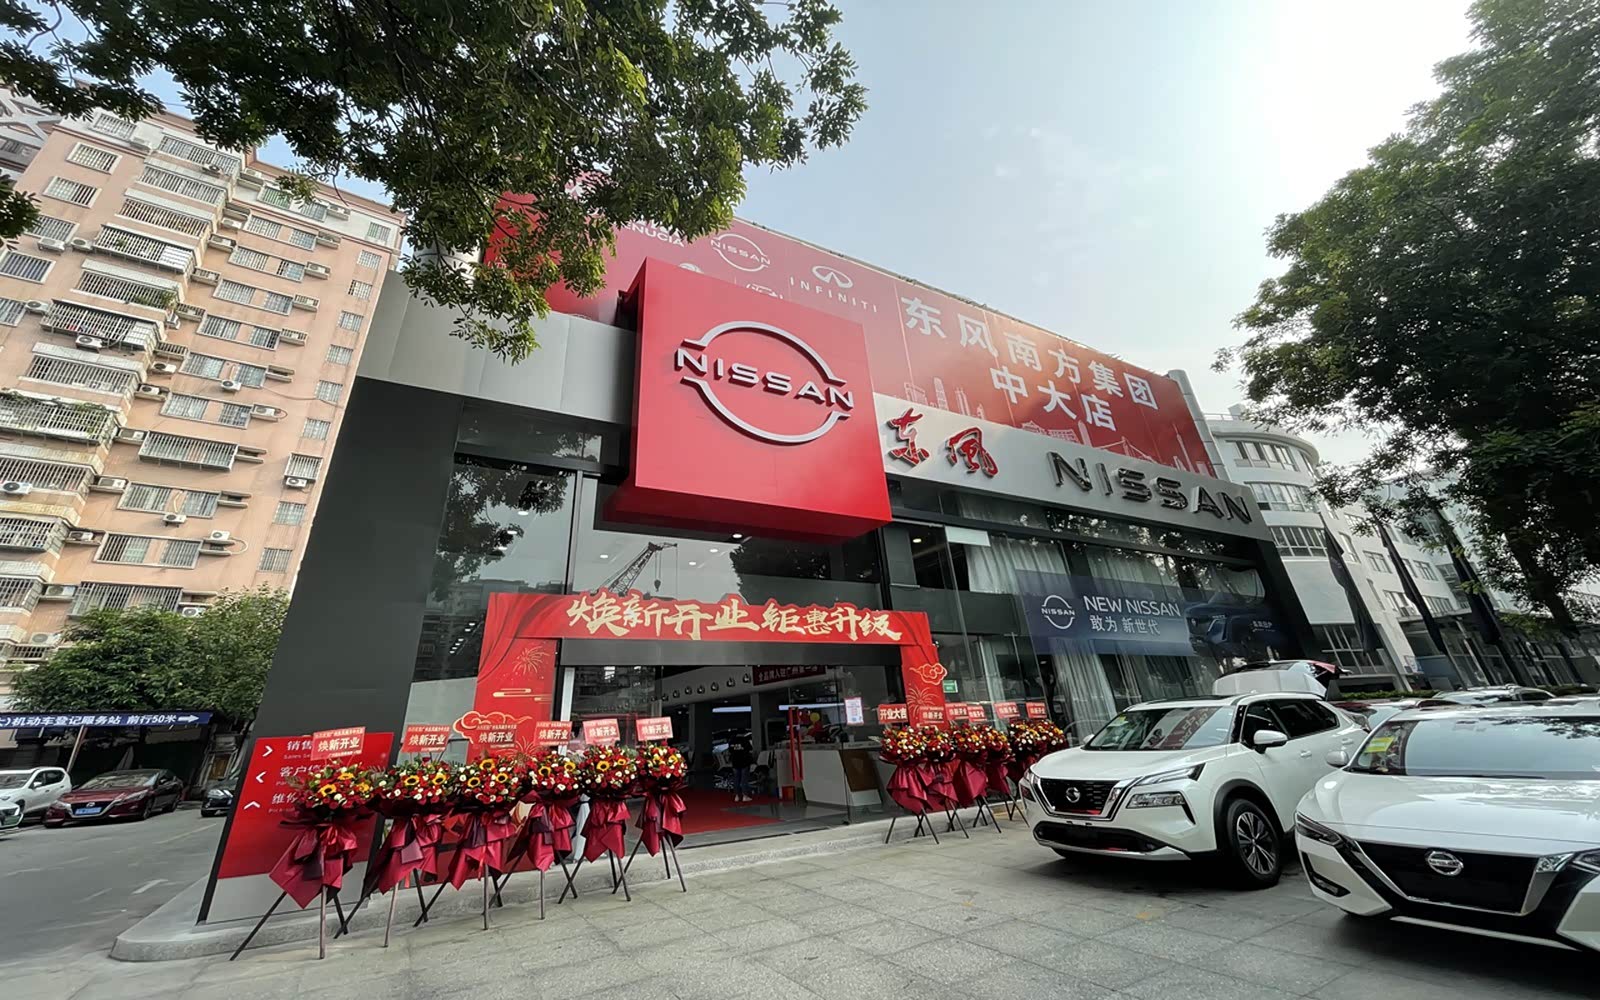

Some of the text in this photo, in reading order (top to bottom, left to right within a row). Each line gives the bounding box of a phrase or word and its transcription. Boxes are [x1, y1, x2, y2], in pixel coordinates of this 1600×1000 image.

[710, 239, 771, 265] NISSAN
[790, 276, 877, 312] INFINITI
[902, 296, 1158, 410] 东风南方集团
[674, 347, 854, 409] NISSAN
[989, 366, 1117, 432] 中大店
[1047, 451, 1253, 524] NISSAN
[566, 592, 902, 642] 焕新开业 钜惠升级
[1041, 608, 1075, 616] NISSAN
[1083, 595, 1181, 617] NEW NISSAN
[1090, 615, 1160, 635] 敢为 新世代
[126, 714, 177, 725] 前行50米
[317, 736, 360, 752] 焕新开业
[408, 734, 446, 746] 焕新开业
[478, 731, 514, 743] 焕新开业
[538, 729, 569, 740] 焕新开业
